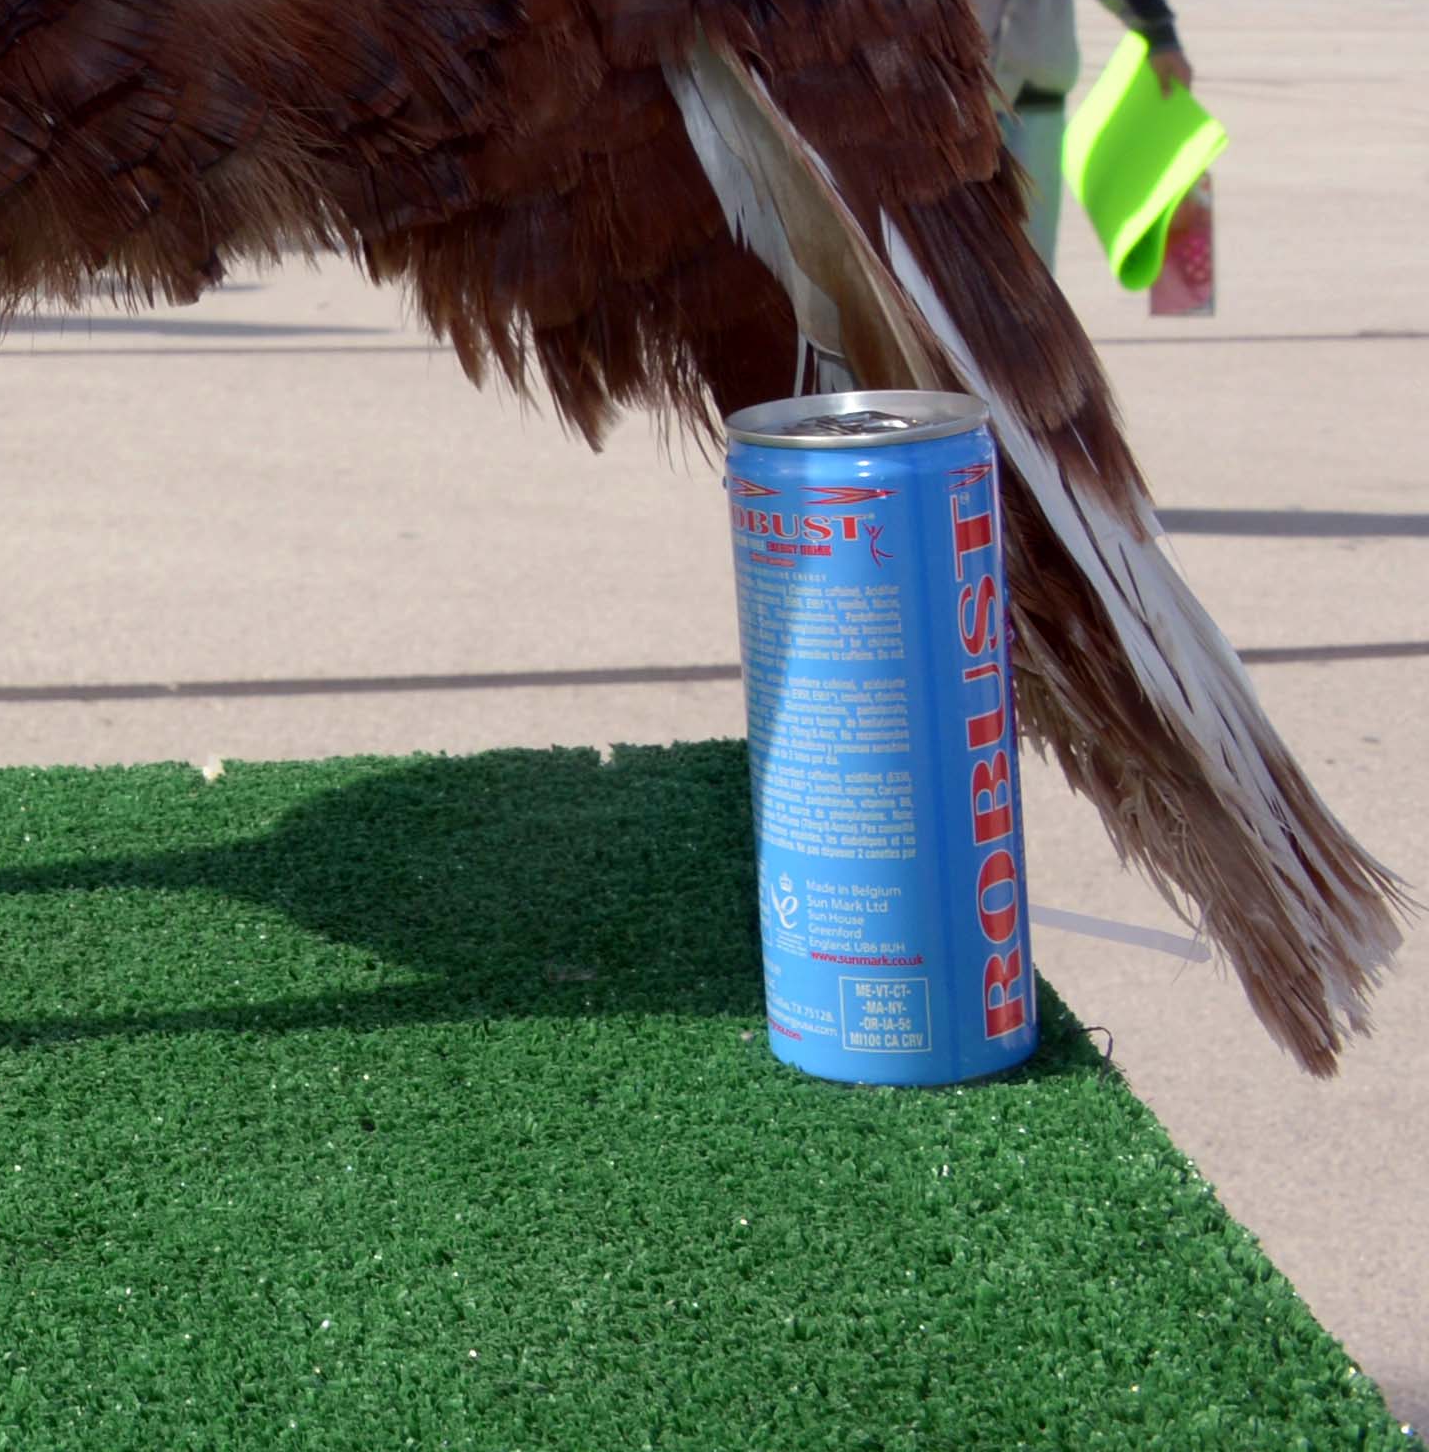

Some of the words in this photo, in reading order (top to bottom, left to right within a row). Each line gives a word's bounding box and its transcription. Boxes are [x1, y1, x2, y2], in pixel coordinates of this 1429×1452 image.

[732, 504, 866, 542] OBUST
[950, 493, 1028, 1041] ROBUST
[806, 880, 836, 894] Made
[839, 883, 849, 895] in
[852, 884, 902, 899] Belgium
[807, 895, 828, 908] Sun
[831, 898, 863, 912] Mark
[866, 899, 888, 913] Ltd
[807, 909, 827, 920] Sun
[829, 912, 865, 925] House
[808, 923, 863, 938] Greenford
[854, 941, 878, 953] UB6
[810, 951, 924, 966] www.sunmark.co.uk
[855, 983, 912, 998] ME-VT-CT-
[884, 1033, 900, 1047] CA
[901, 1033, 924, 1047] CRV
